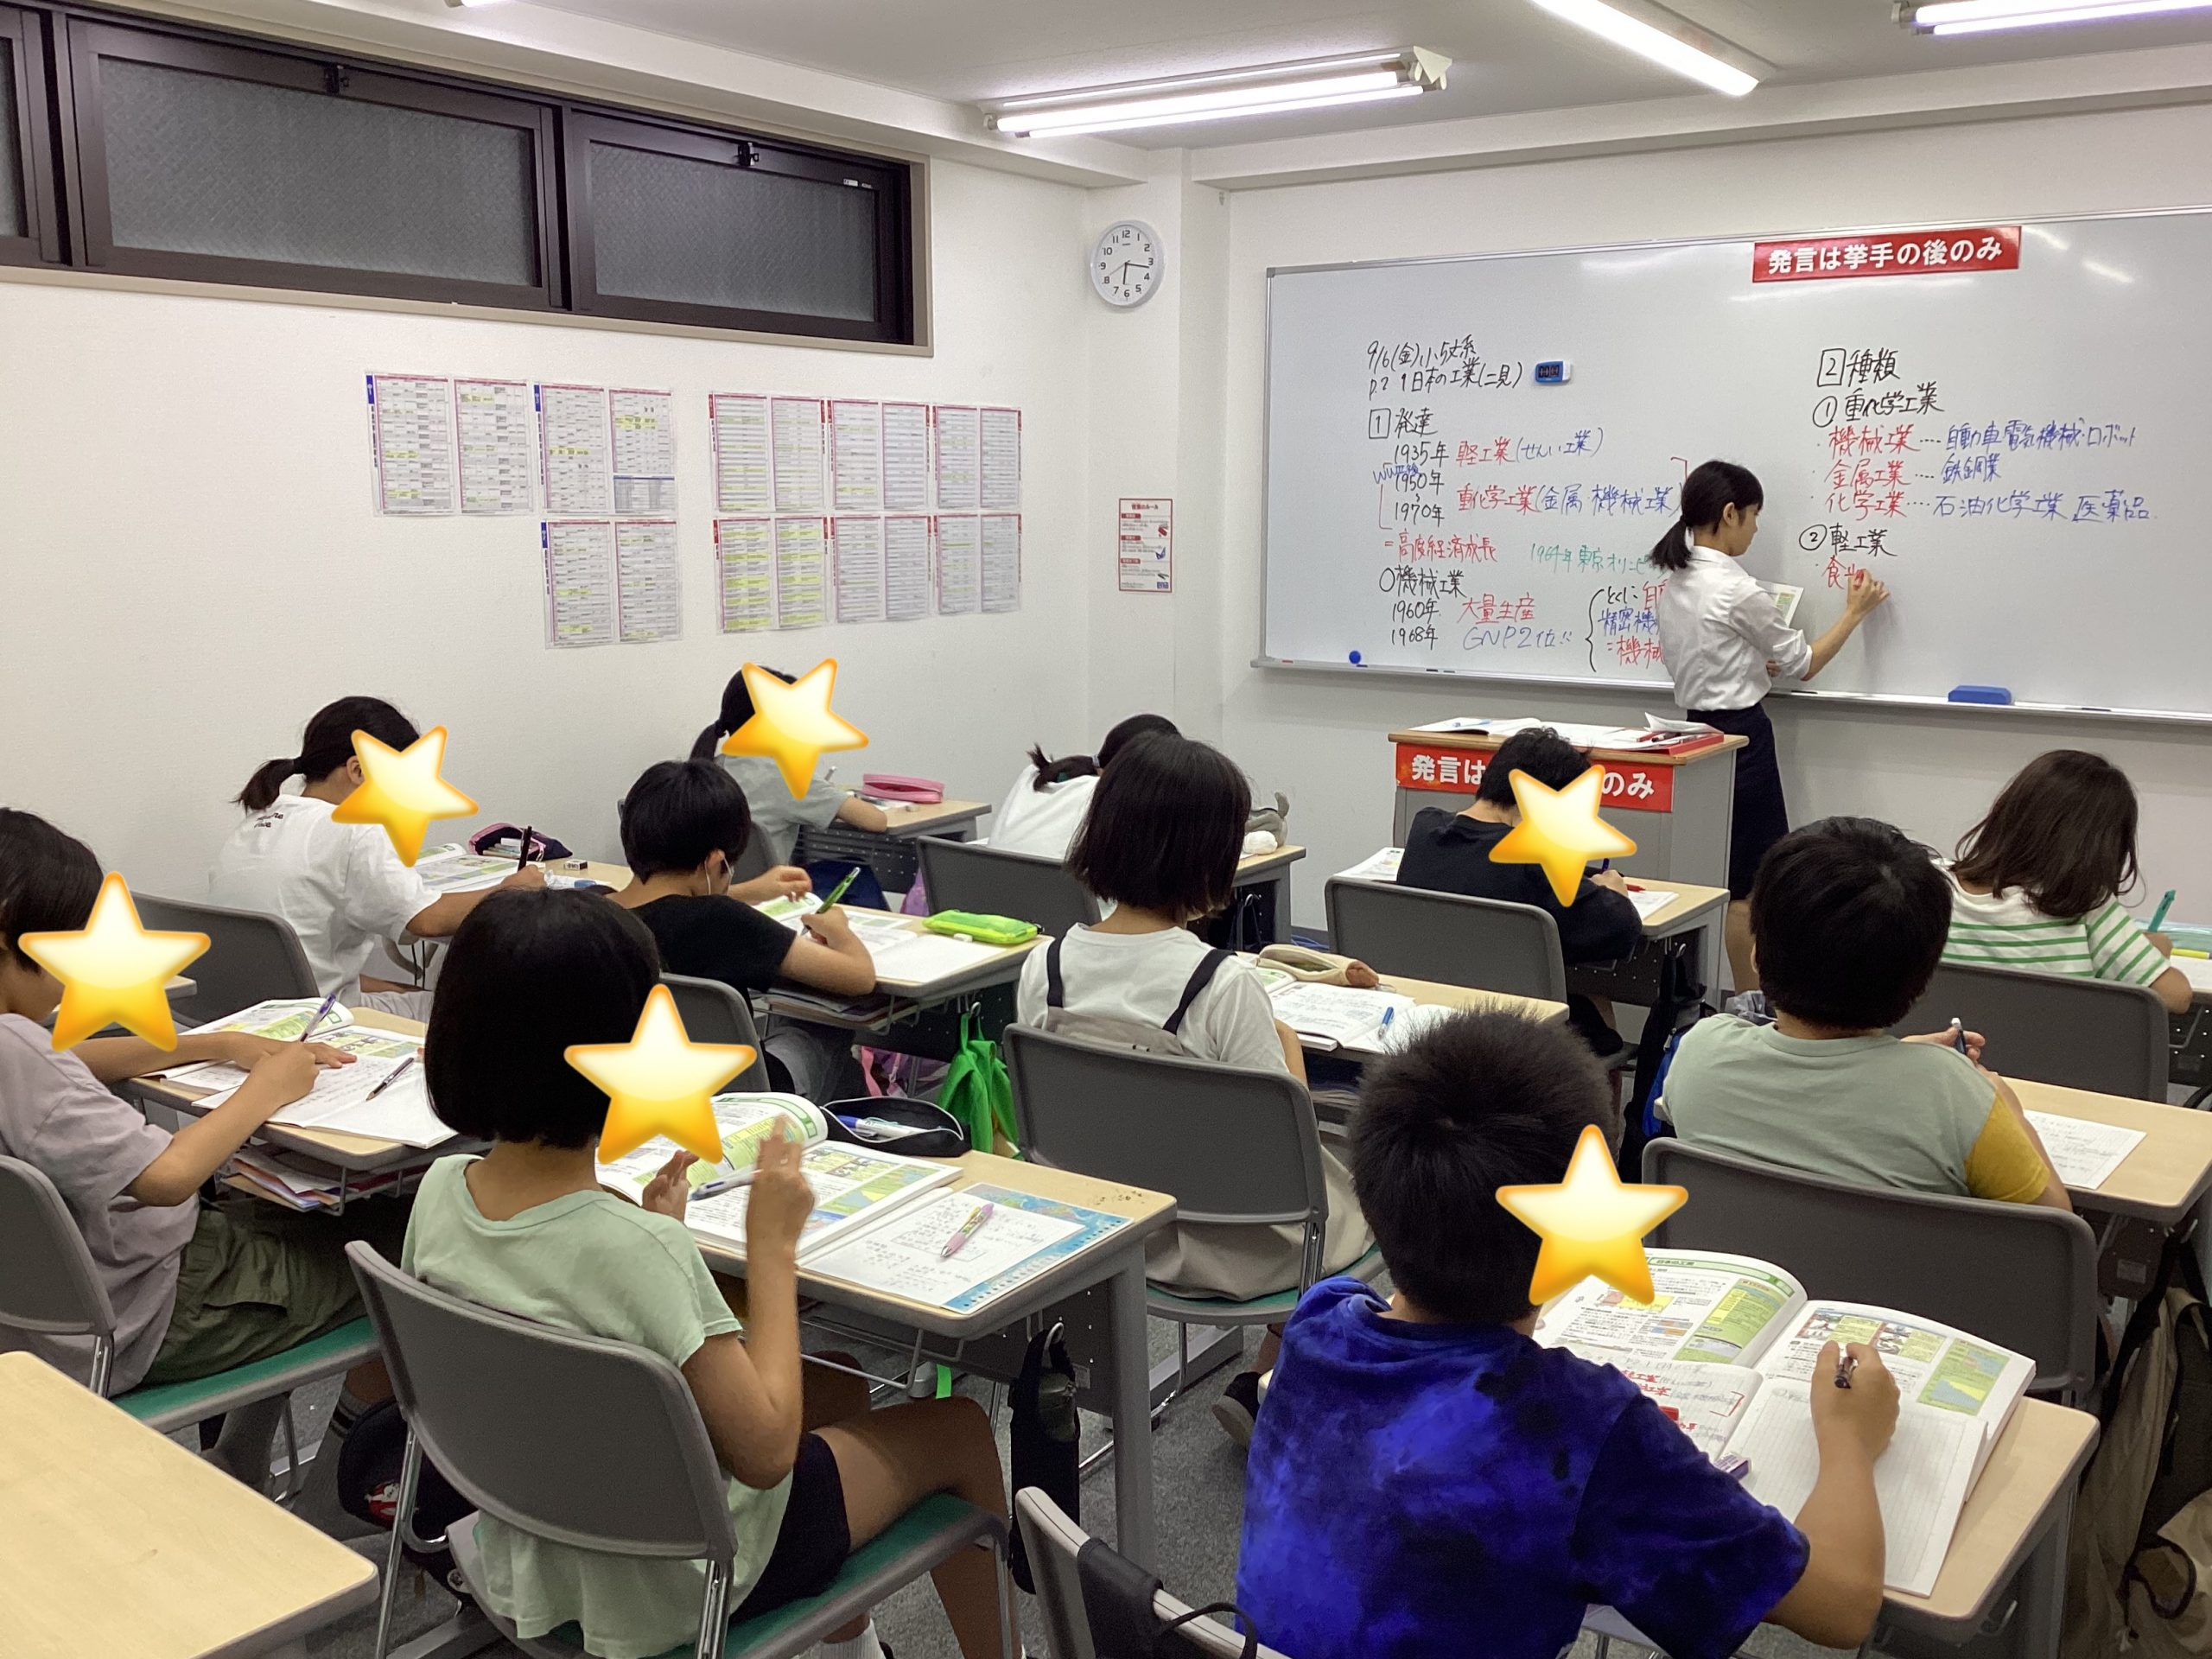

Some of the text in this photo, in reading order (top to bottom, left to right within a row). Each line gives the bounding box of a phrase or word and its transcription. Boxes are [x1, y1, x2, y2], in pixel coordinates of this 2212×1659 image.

[1112, 235, 1119, 244] 11
[1122, 230, 1130, 238] 12
[1103, 247, 1113, 256] 10
[1768, 236, 2003, 275] 発言は挙手の後のみ
[1395, 441, 1449, 467] 1935年
[1395, 470, 1445, 495] 1950年
[1395, 502, 1445, 528] 1970年
[1825, 489, 1907, 521] 化学工業
[1392, 592, 1535, 624] 1960年 大量生産
[1391, 624, 1438, 650] 1968年
